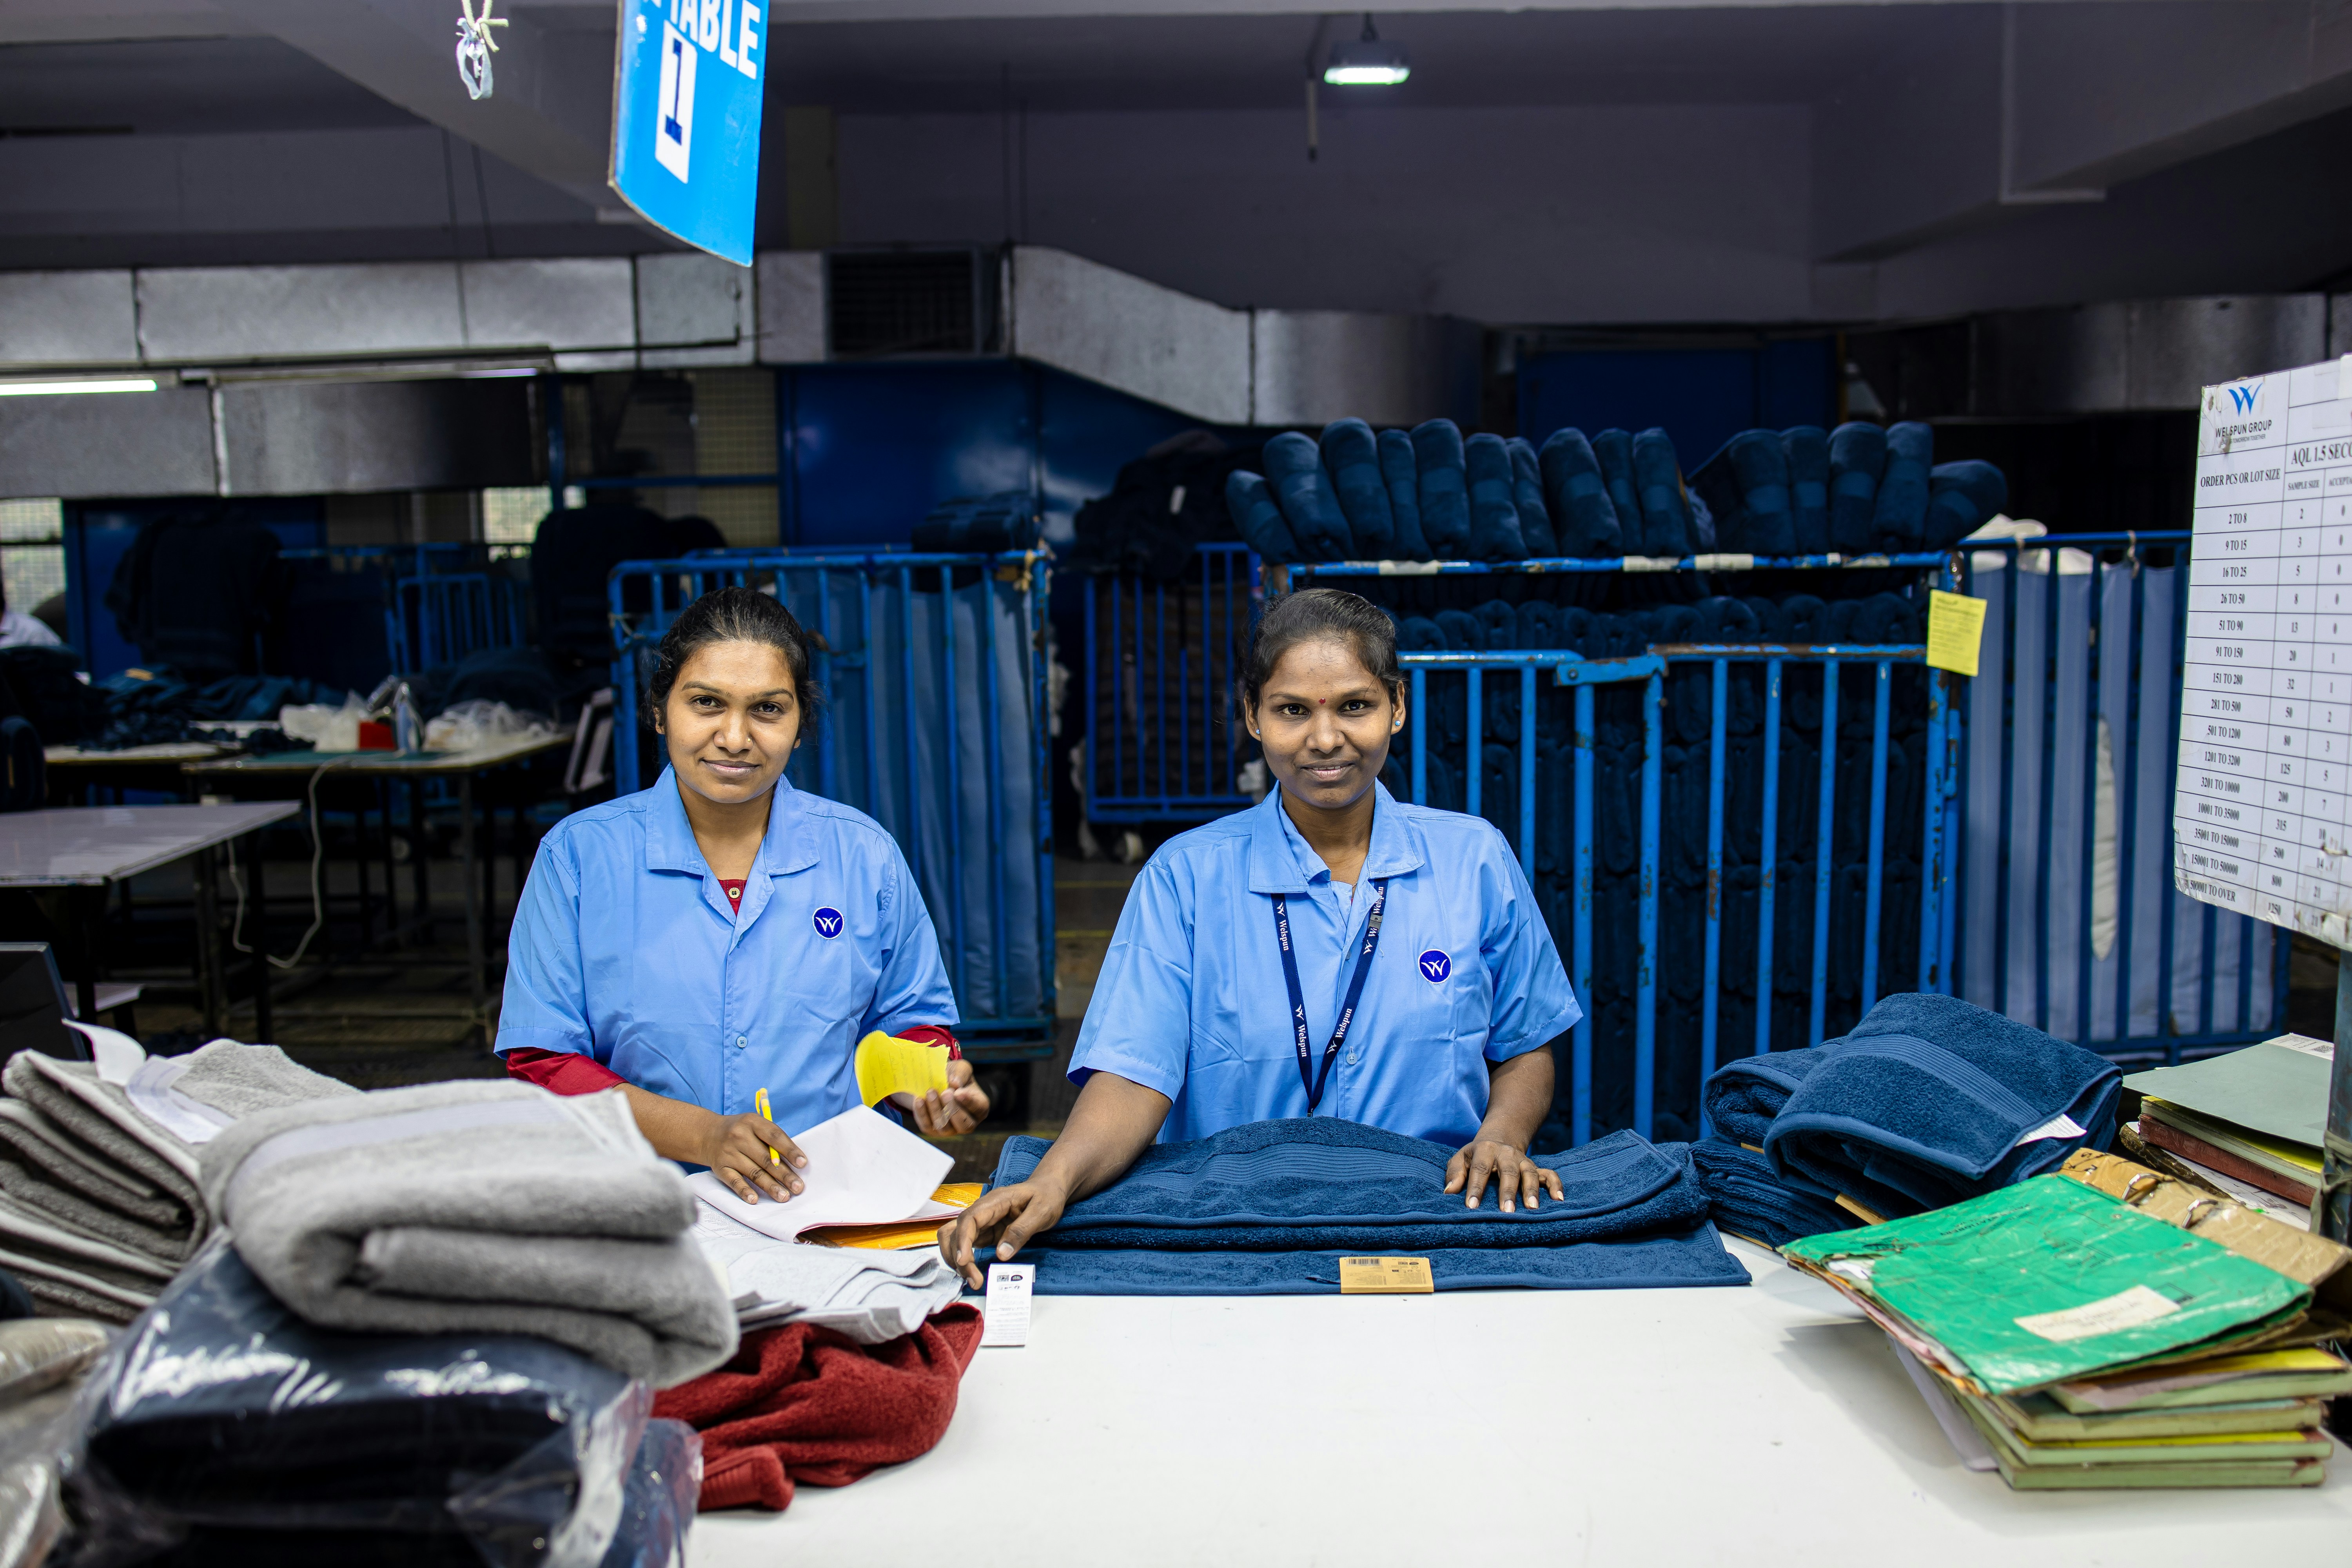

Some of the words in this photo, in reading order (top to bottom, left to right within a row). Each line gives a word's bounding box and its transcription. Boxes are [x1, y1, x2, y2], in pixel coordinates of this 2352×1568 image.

[2216, 424, 2247, 437] WELSPUN
[2249, 419, 2272, 433] GROUP
[2291, 447, 2312, 466] AQL
[2314, 445, 2326, 461] 1.5
[2201, 475, 2224, 487] ORDER
[2226, 474, 2238, 485] PCS
[2239, 472, 2249, 484] OR
[2250, 470, 2264, 483] LOT
[2265, 468, 2281, 481] SIZE
[2288, 481, 2307, 490] SAMPLE
[2308, 480, 2319, 488] SIZE
[2229, 514, 2232, 524] 2
[2234, 514, 2242, 523] TO
[2244, 513, 2247, 523] 8
[2299, 508, 2304, 519] 2
[2226, 540, 2229, 550] 9
[2230, 540, 2239, 550] TO
[2241, 539, 2247, 550] 15
[2298, 537, 2302, 547] 3
[2223, 567, 2229, 577] 16
[2230, 567, 2239, 577] TO
[2240, 567, 2247, 577] 25
[2296, 565, 2300, 576] 5
[2221, 593, 2227, 604] 26
[2229, 593, 2237, 604] TO
[2238, 593, 2245, 604] 50
[2219, 620, 2225, 630] 51
[2227, 620, 2235, 630] TO
[2237, 621, 2243, 631] 90
[2292, 622, 2298, 633] 13
[2216, 646, 2222, 657] 91
[2223, 647, 2232, 657] TO
[2234, 647, 2243, 658] 150
[2289, 650, 2296, 661] 20
[2332, 652, 2335, 664] 1
[2213, 673, 2222, 683] 151
[2223, 673, 2232, 684] TO
[2234, 674, 2243, 685] 280
[2287, 678, 2294, 689] 32
[2330, 682, 2333, 693] 1
[2211, 699, 2220, 710] 281
[2221, 700, 2230, 710] TO
[2231, 701, 2241, 712] 500
[2285, 706, 2293, 718] 50
[2327, 711, 2332, 723] 2
[2207, 725, 2217, 736] 501
[2218, 726, 2227, 737] TO
[2228, 728, 2241, 739] 1200
[2325, 740, 2330, 752] 3
[2205, 751, 2216, 762] 1201
[2218, 753, 2227, 764] TO
[2227, 754, 2240, 766] 3200
[2280, 763, 2291, 775] 125
[2323, 769, 2328, 781] 5
[2201, 776, 2213, 788] 3201
[2215, 779, 2223, 790] TO
[2224, 781, 2240, 793] 10000
[2278, 791, 2288, 803] 200
[2198, 802, 2212, 815] 10001
[2214, 806, 2223, 817] TO
[2224, 808, 2239, 821] 35000
[2276, 818, 2287, 831] 315
[2194, 828, 2209, 840] 35001
[2211, 831, 2219, 843] TO
[2221, 834, 2239, 848] 150000
[2274, 847, 2285, 859] 500
[2191, 853, 2209, 867] 150001
[2210, 858, 2219, 870] TO
[2220, 861, 2238, 875] 500000
[2317, 857, 2324, 869] 14
[2190, 880, 2207, 894] 500001
[2209, 885, 2217, 897] TO
[2218, 887, 2236, 902] OVER
[1279, 920, 1289, 951] Welspun
[1335, 1008, 1352, 1038] Welspun
[1298, 1024, 1307, 1057] Welspun
